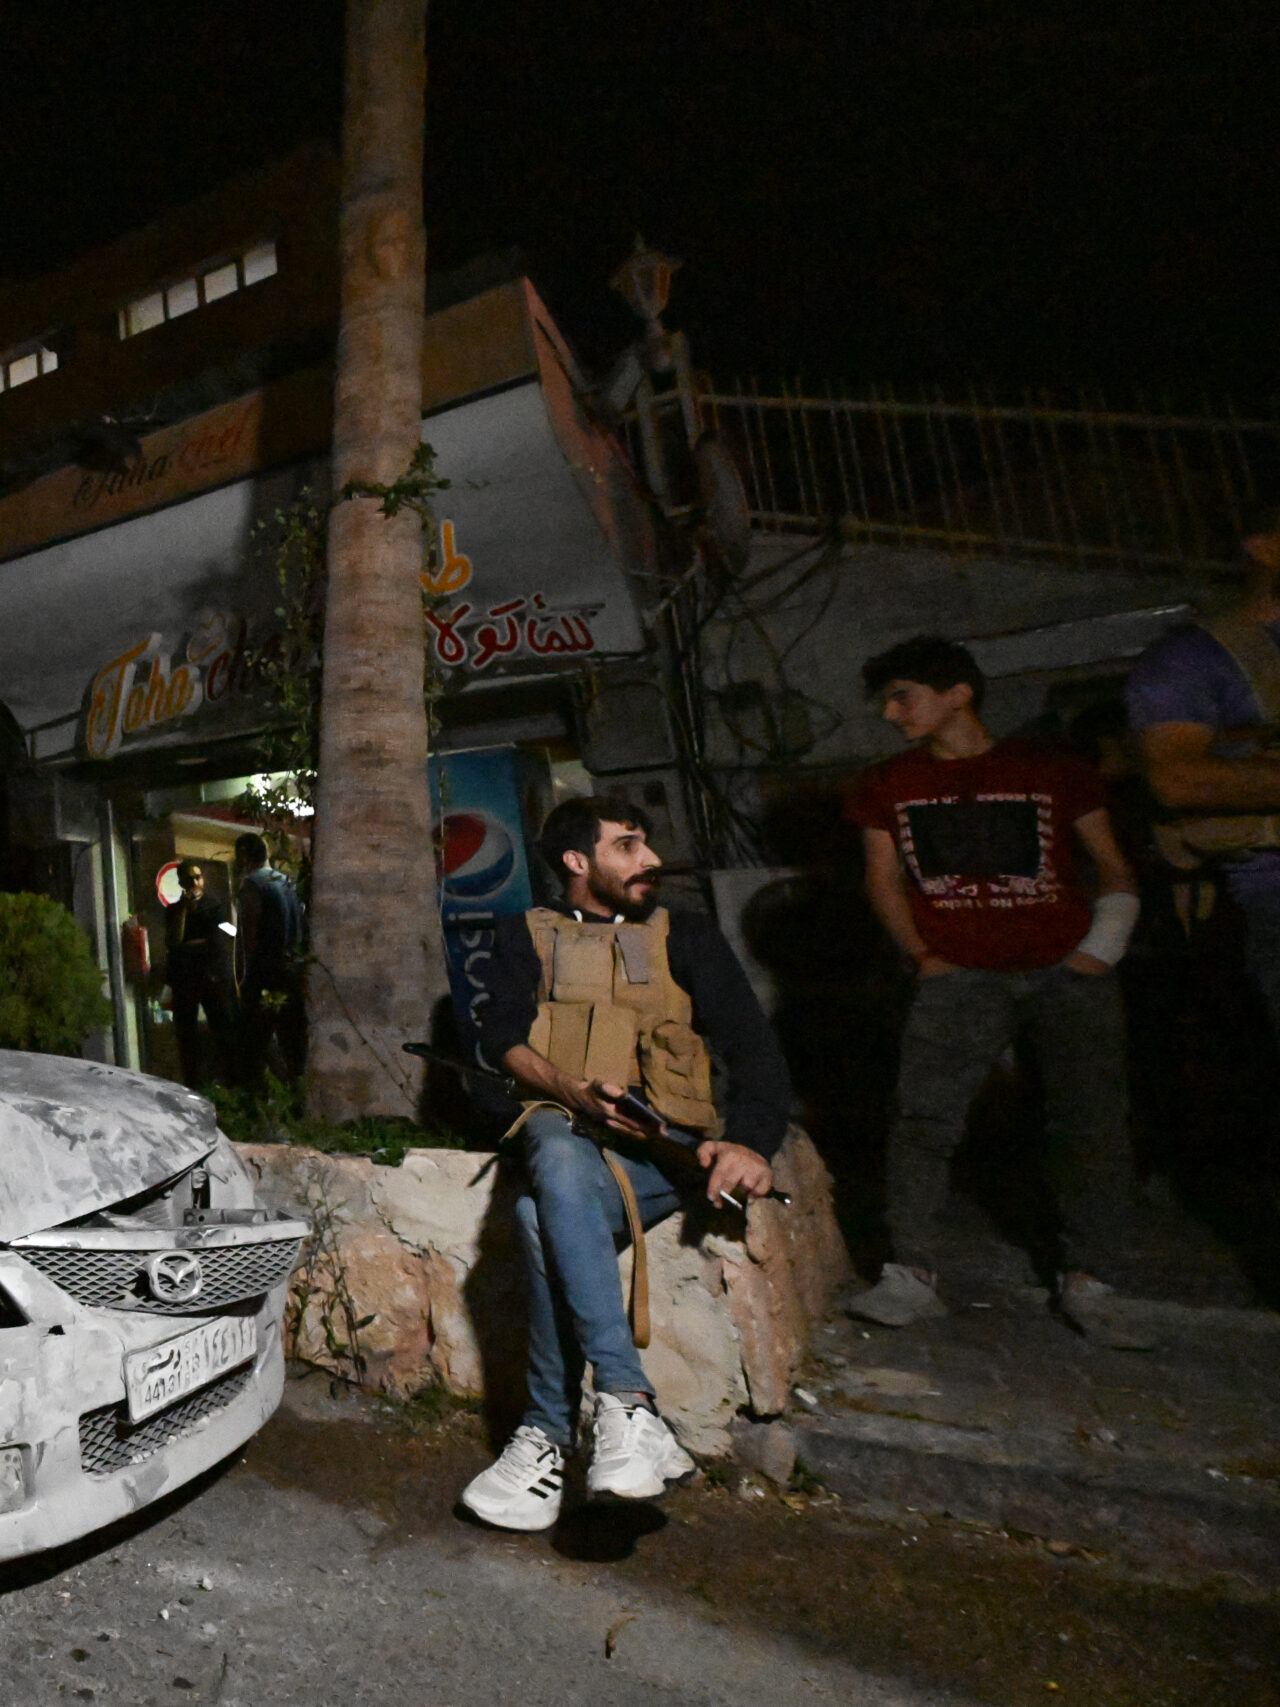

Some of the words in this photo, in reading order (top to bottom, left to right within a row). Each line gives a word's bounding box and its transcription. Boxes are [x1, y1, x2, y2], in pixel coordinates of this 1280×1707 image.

[421, 522, 469, 594] ط
[424, 594, 595, 667] للمأكولا
[87, 631, 204, 758] Taha
